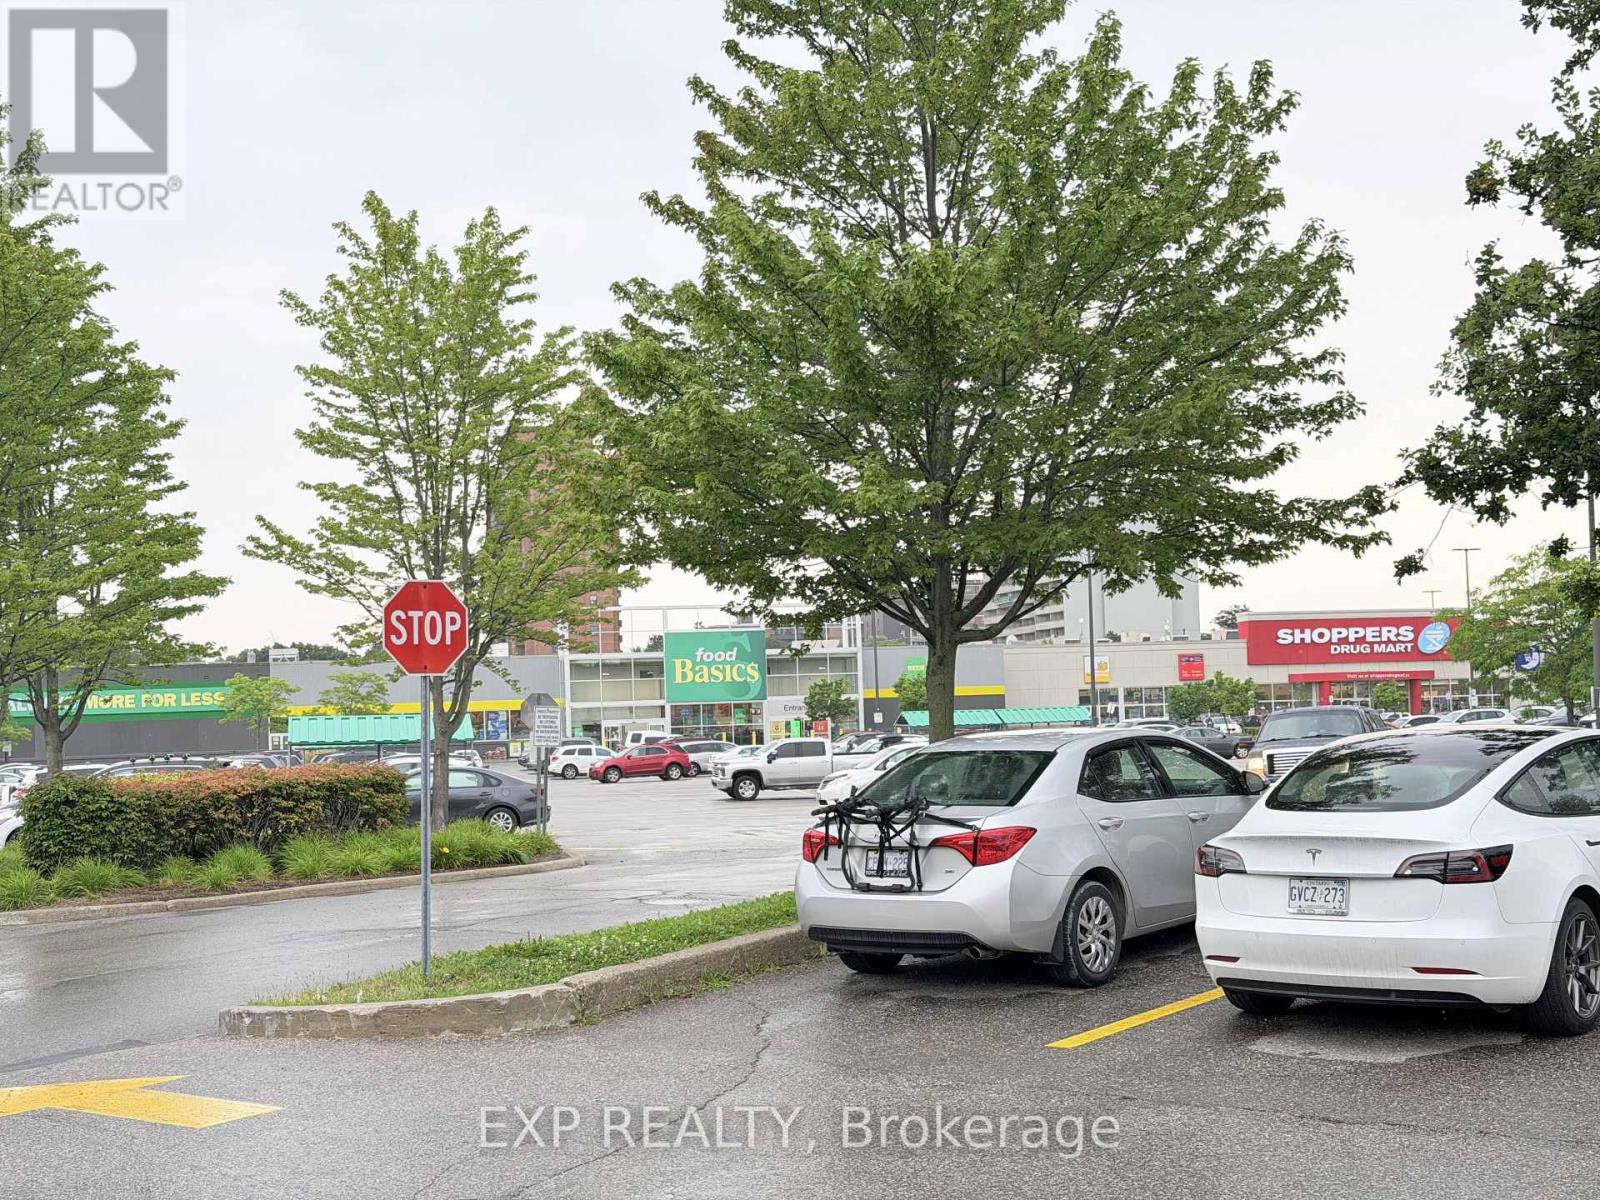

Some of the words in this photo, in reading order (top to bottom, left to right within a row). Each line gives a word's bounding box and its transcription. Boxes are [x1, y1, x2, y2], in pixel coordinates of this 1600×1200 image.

[390, 610, 462, 646] STOP
[1276, 626, 1414, 645] SHOPPERS
[695, 647, 737, 662] food
[1330, 644, 1371, 655] DRUG
[1373, 643, 1414, 654] MART
[84, 694, 136, 709] MORE
[141, 693, 177, 708] FOR
[180, 691, 225, 706] LESS
[1290, 886, 1317, 902] GVCZ
[1324, 887, 1345, 903] 273
